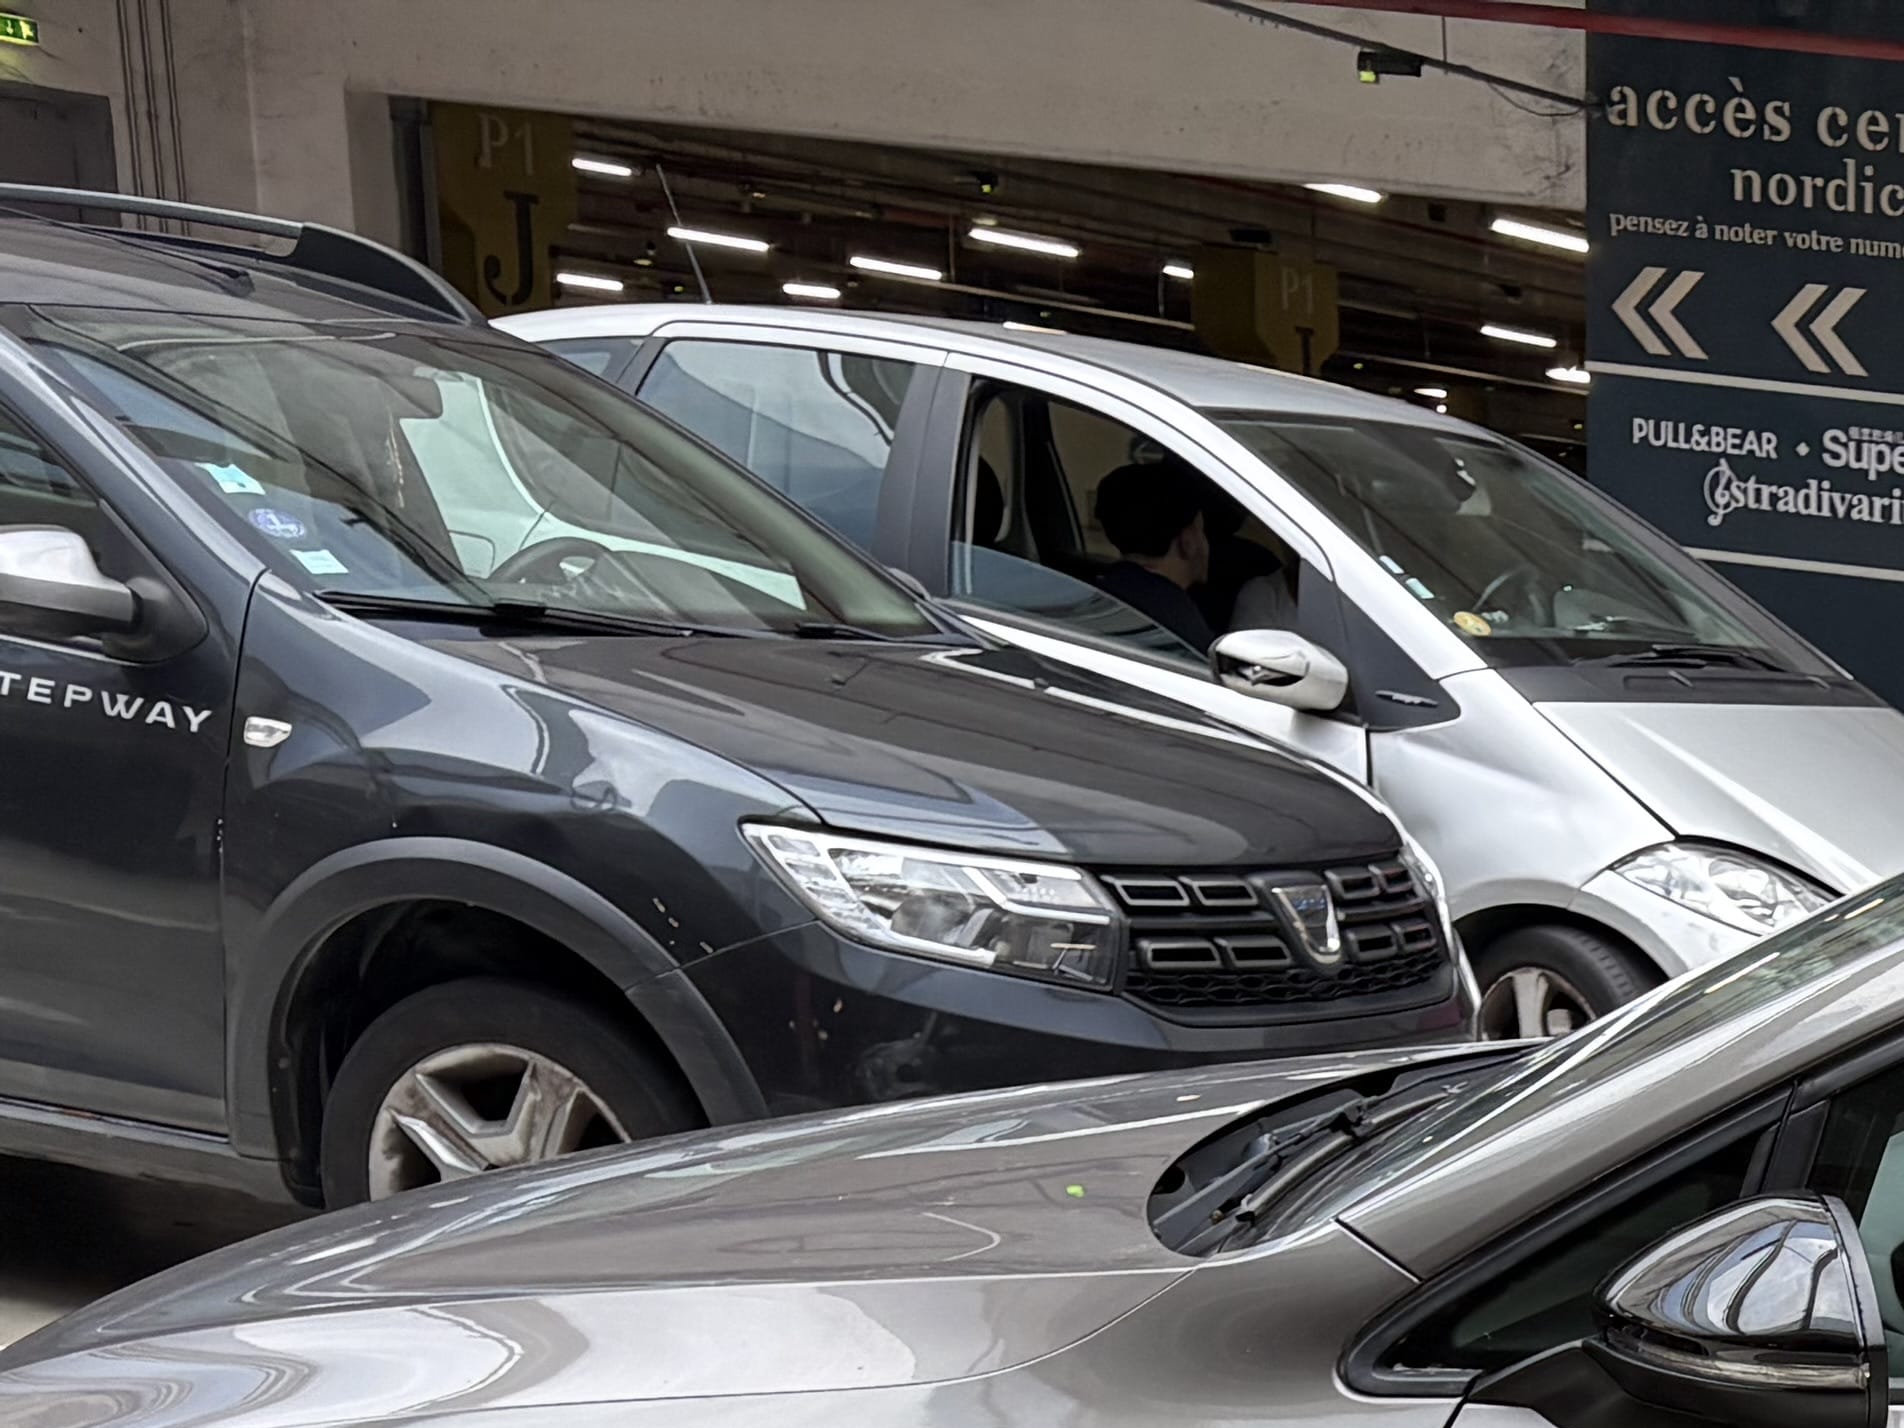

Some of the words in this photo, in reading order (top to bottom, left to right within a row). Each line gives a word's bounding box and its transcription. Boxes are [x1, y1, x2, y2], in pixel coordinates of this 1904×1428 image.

[1606, 76, 1792, 143] accès
[476, 111, 535, 177] P1
[484, 190, 540, 306] J
[1609, 212, 1689, 237] pensez
[1694, 216, 1709, 240] à
[1714, 223, 1777, 246] noter
[1784, 229, 1844, 254] votre
[1632, 417, 1778, 460] PULL&BEAR
